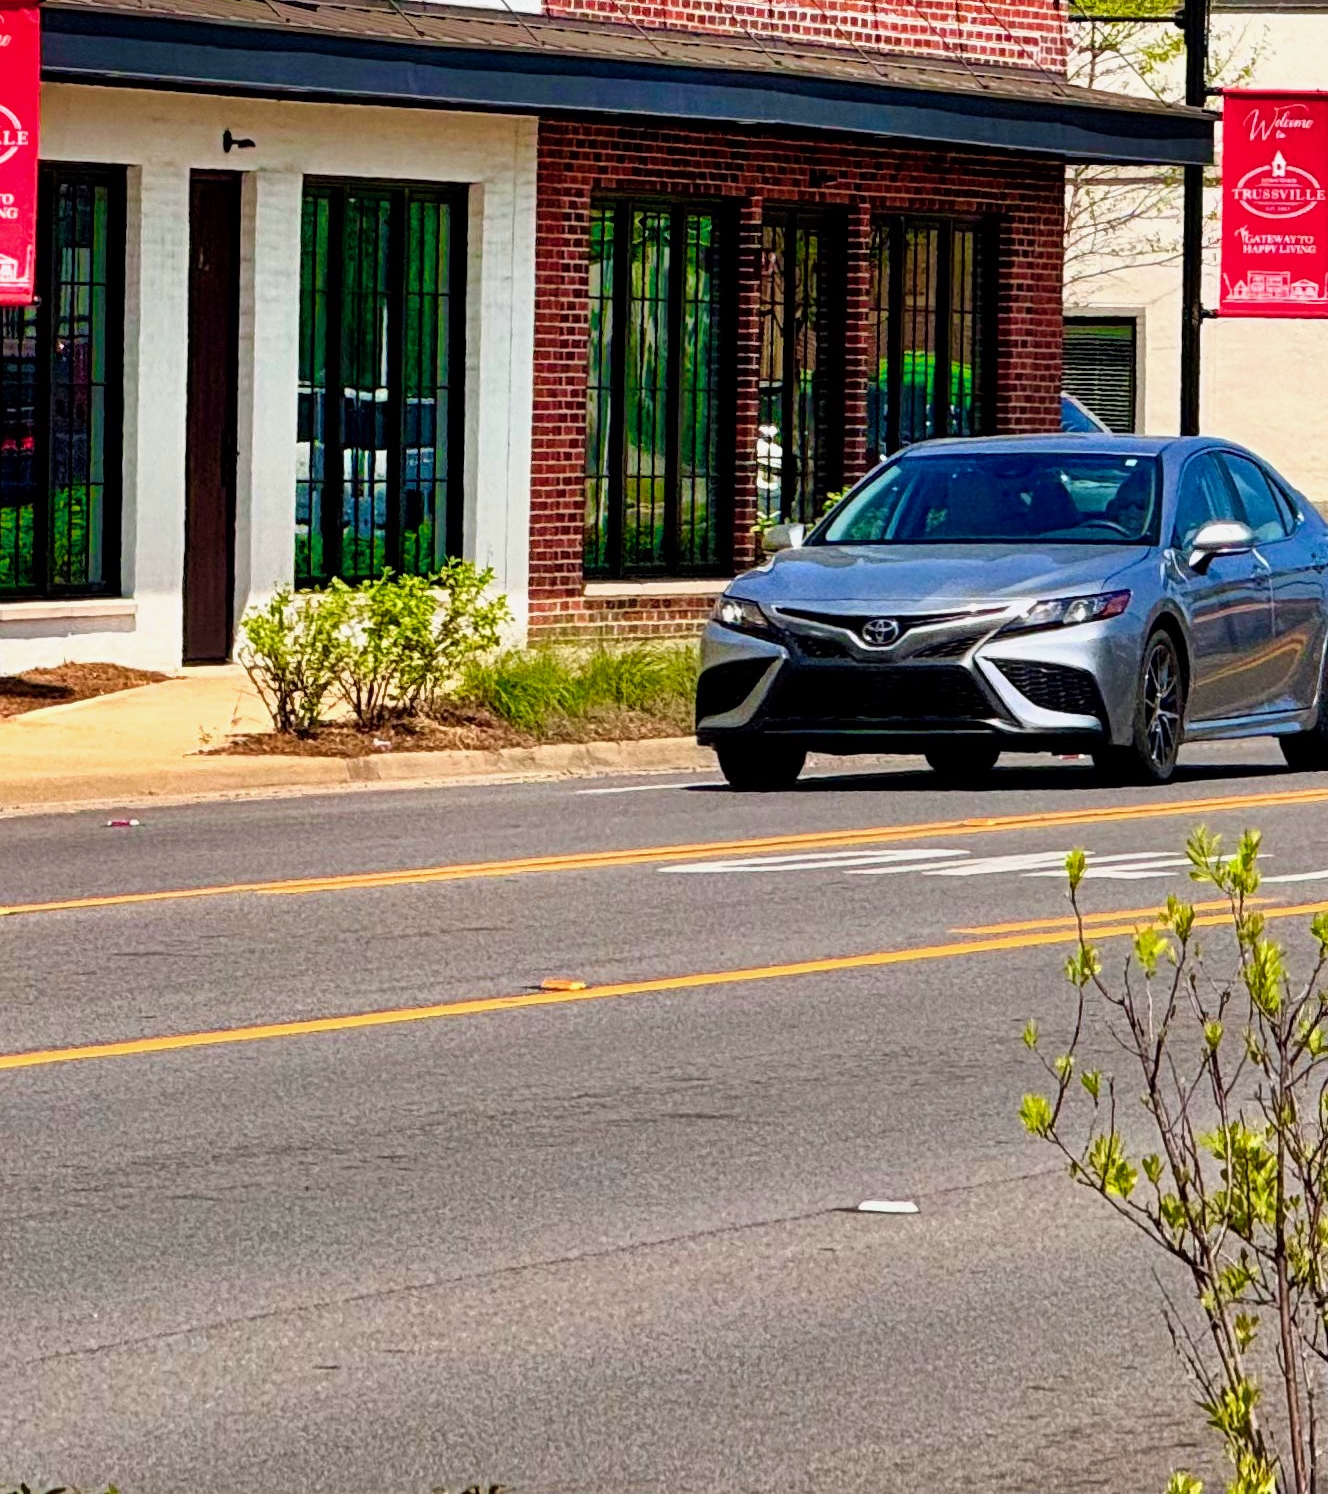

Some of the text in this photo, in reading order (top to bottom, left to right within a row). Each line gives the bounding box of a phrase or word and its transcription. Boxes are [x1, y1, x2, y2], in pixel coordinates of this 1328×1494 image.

[1243, 104, 1314, 141] Welcome
[1231, 187, 1327, 202] TRUSSVILLE
[1246, 234, 1315, 245] GATEWAY TO
[1242, 244, 1317, 255] HAPPY LIVING
